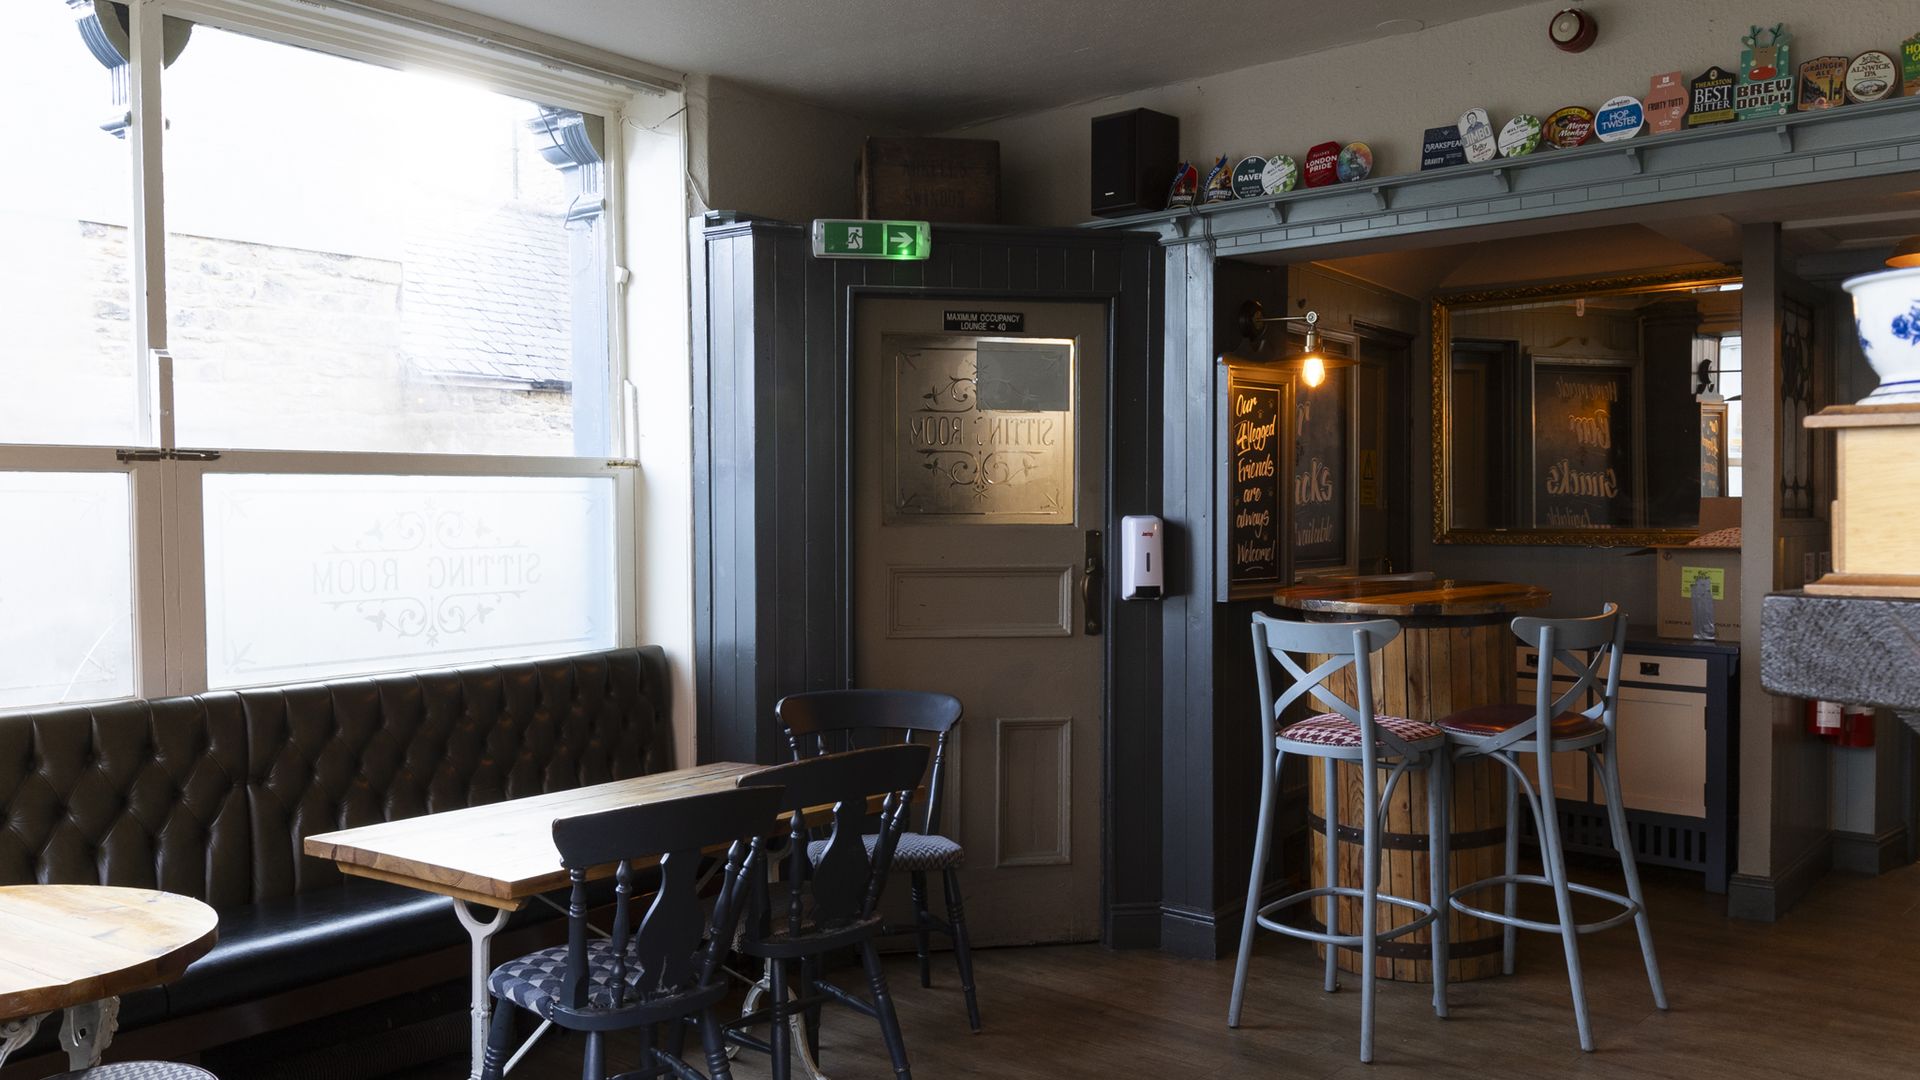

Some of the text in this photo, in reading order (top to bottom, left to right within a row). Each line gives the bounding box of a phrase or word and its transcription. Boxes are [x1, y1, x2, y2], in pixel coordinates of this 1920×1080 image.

[1851, 63, 1890, 73] ALNWICK
[1695, 78, 1732, 88] THEAKSTON
[1736, 78, 1792, 97] BREW
[1694, 85, 1732, 104] BEST
[1736, 91, 1791, 109] DOLPH
[1647, 97, 1684, 112] FRUITY TUTTI
[1693, 101, 1730, 113] BITTER
[1609, 109, 1629, 120] HOP
[1566, 122, 1590, 131] Merry
[1602, 116, 1637, 130] TWISTER
[1464, 126, 1491, 146] JIMBO
[1558, 129, 1588, 137] Monkey
[1305, 154, 1338, 169] LONDON
[1309, 162, 1332, 174] PRIDE
[1424, 157, 1444, 166] GRAVITY
[946, 312, 1020, 323] MAXIMUM OCCUPANCY
[960, 322, 987, 330] LOUNGE
[997, 323, 1006, 331] 40
[1236, 394, 1257, 417] Our
[1238, 453, 1275, 483] Friends
[1243, 487, 1262, 504] are
[1236, 508, 1270, 539] always
[1237, 540, 1276, 566] Welcome!
